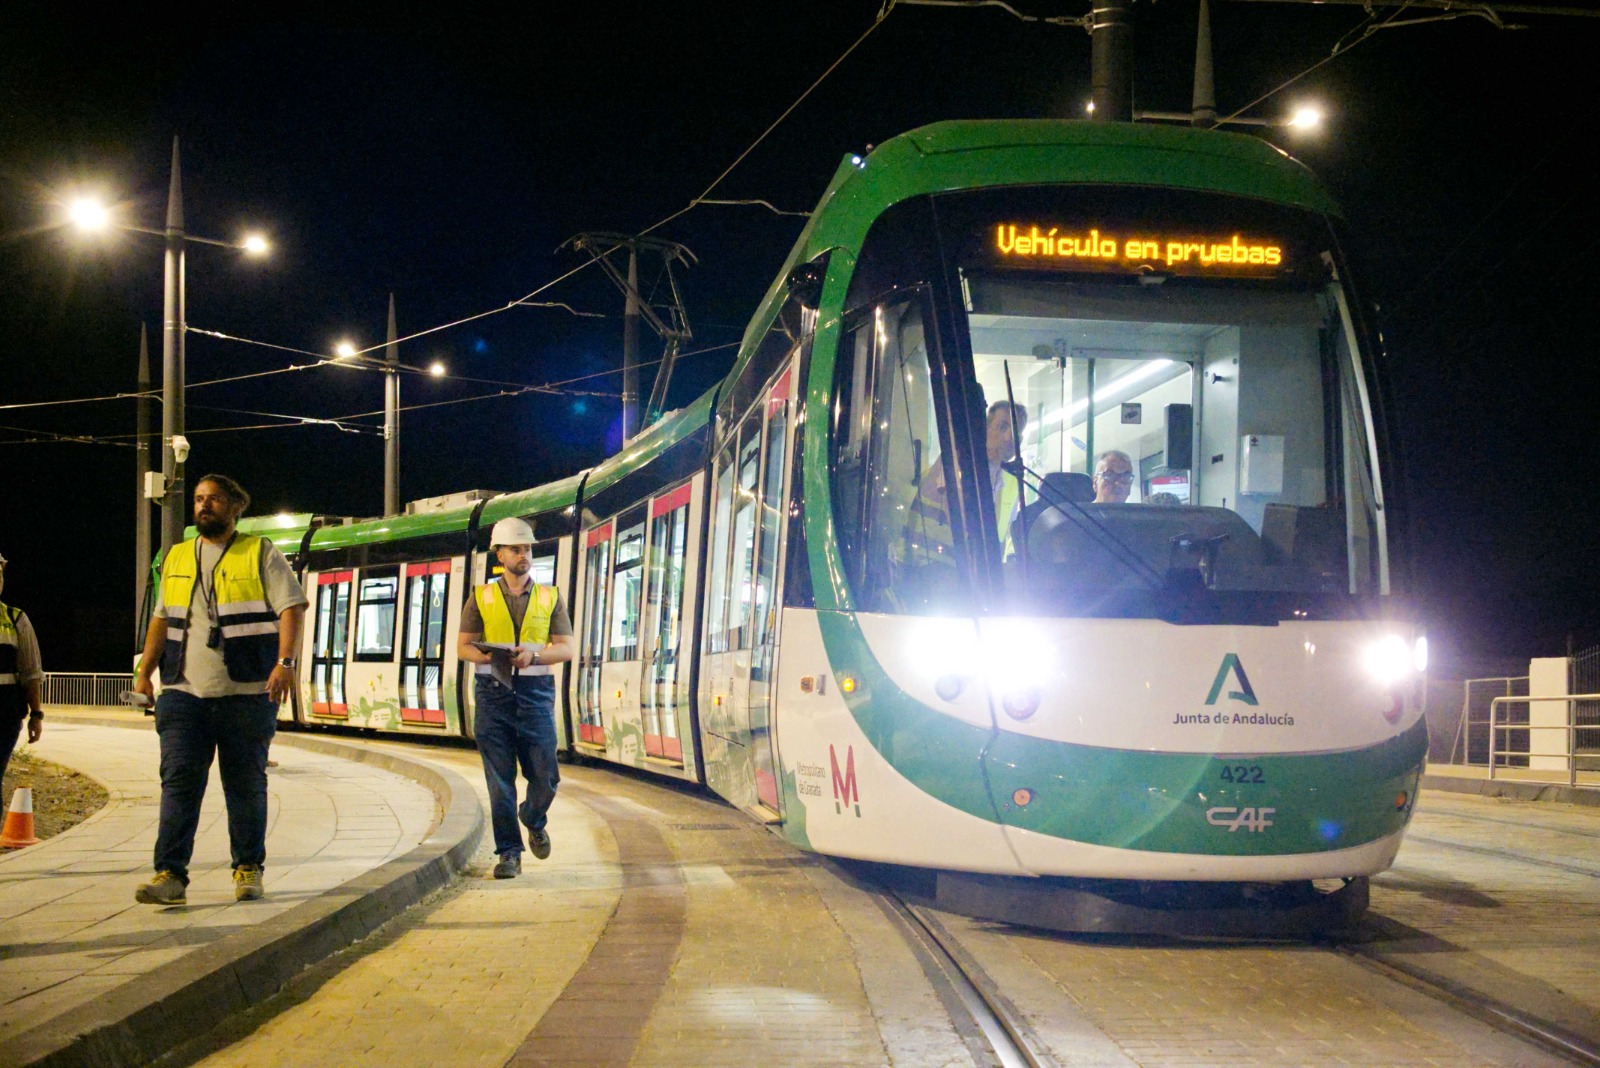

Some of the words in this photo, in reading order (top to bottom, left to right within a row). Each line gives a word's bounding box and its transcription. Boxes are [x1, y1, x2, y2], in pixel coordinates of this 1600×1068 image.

[996, 225, 1117, 258] Vehículo
[1125, 241, 1159, 260] en
[1167, 235, 1281, 265] pruebas
[1173, 713, 1210, 725] Junta
[1213, 712, 1230, 724] de
[1232, 712, 1295, 726] Andalucía
[1220, 765, 1266, 784] 422
[1206, 806, 1276, 833] CAF
